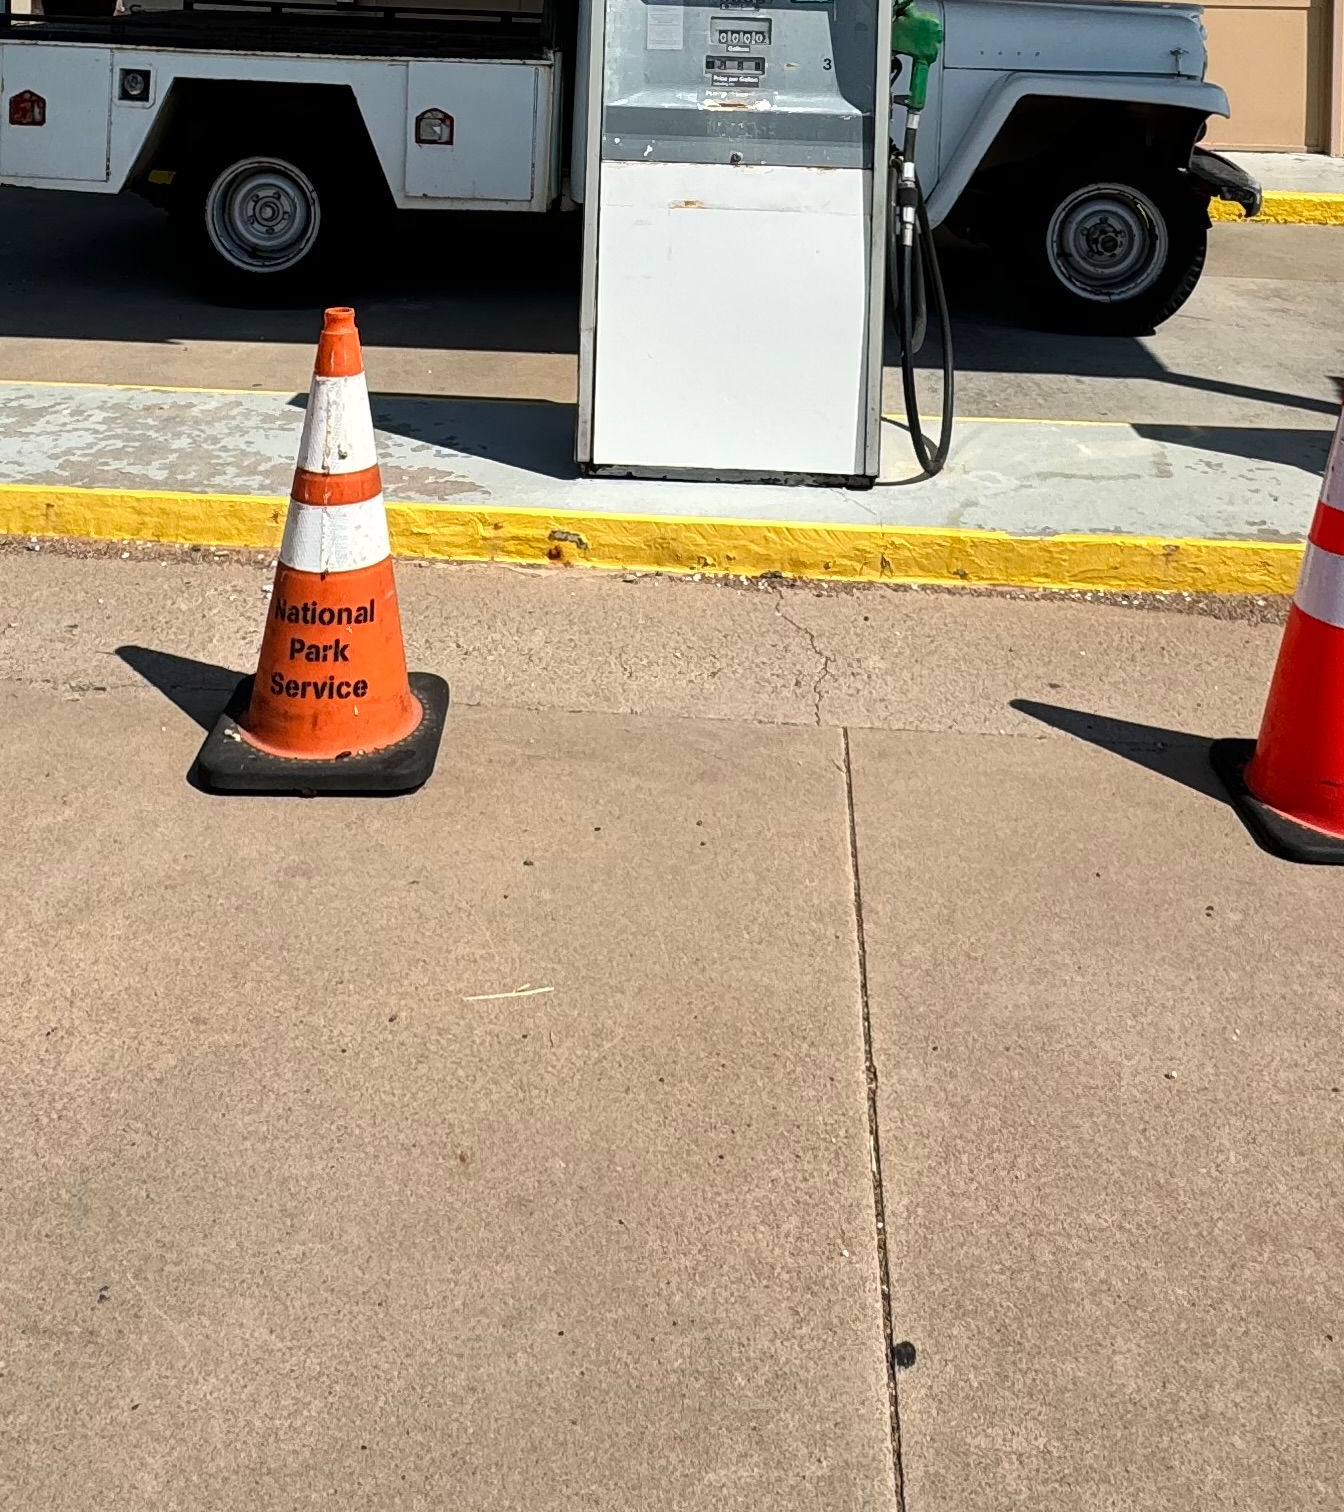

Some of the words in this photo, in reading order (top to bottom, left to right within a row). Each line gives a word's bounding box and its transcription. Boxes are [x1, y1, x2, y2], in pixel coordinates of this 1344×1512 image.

[823, 58, 832, 71] 3
[274, 598, 375, 626] National
[289, 638, 350, 663] Park
[270, 671, 369, 700] Service
